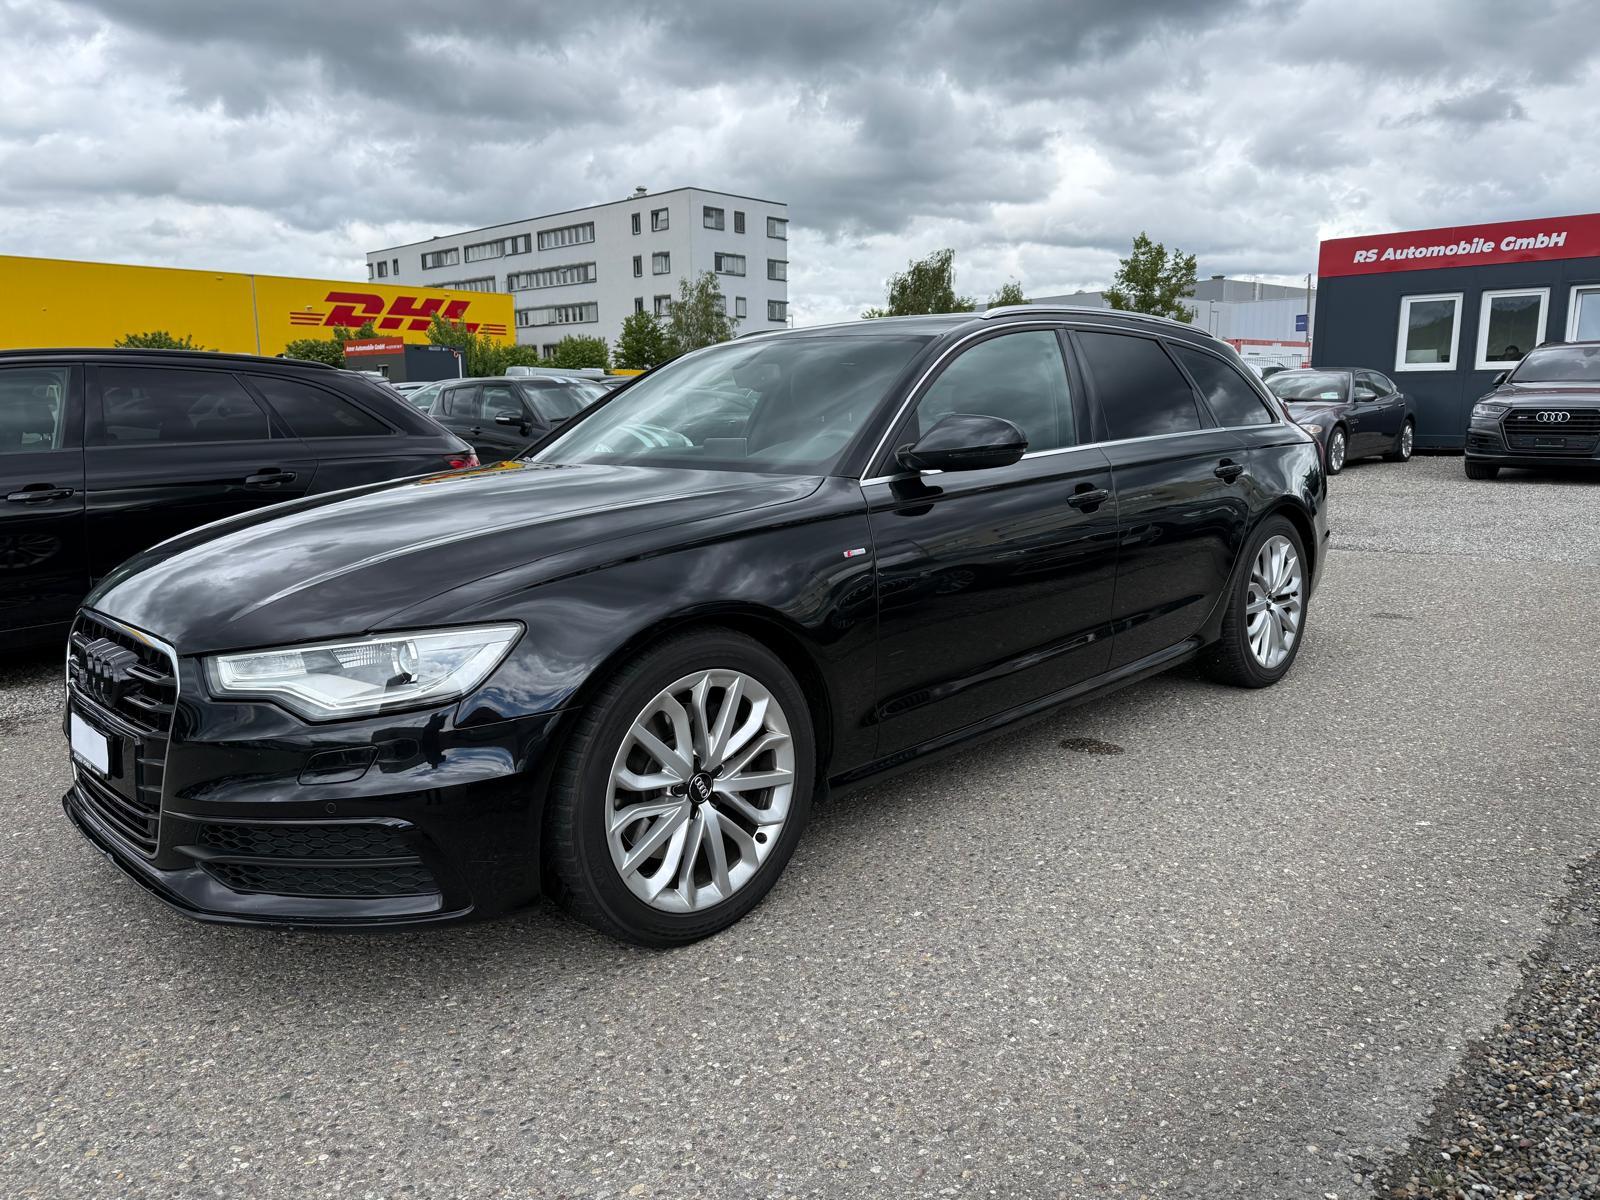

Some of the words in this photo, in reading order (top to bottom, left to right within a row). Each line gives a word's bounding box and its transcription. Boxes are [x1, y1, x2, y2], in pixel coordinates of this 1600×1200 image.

[1353, 249, 1378, 264] RS
[1381, 238, 1495, 262] Automobile
[1500, 232, 1567, 252] GmbH
[323, 291, 480, 334] DHL
